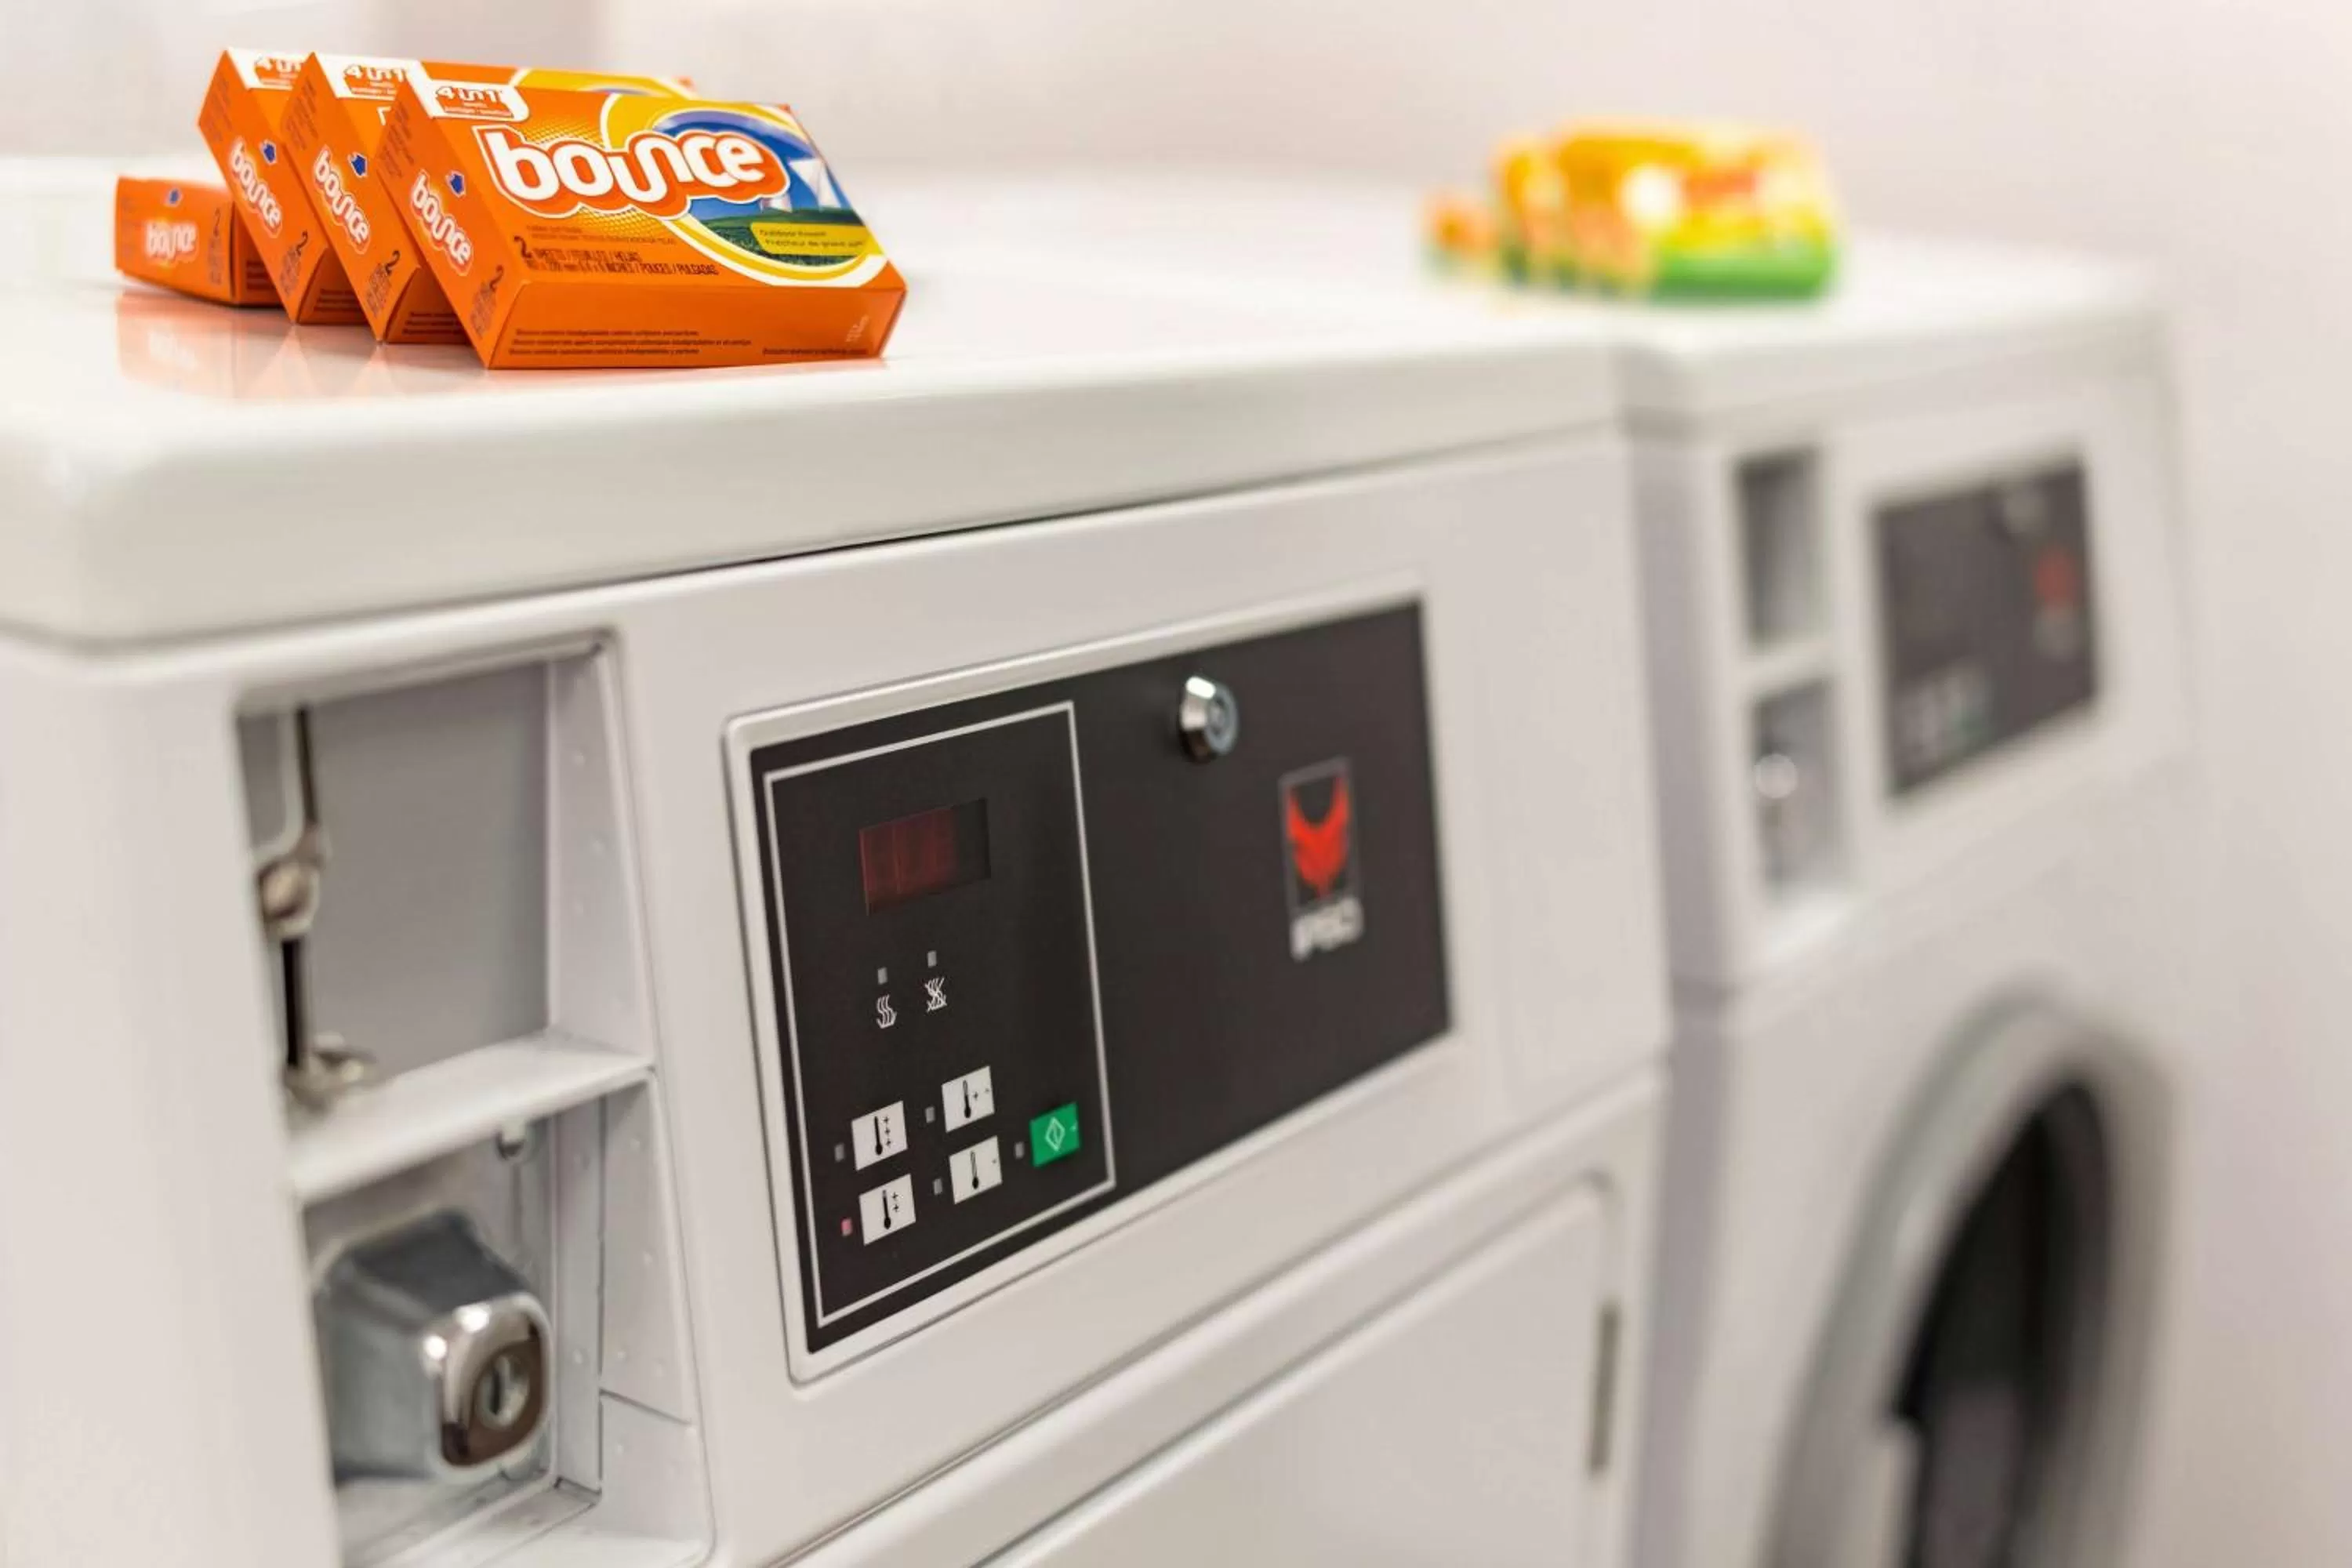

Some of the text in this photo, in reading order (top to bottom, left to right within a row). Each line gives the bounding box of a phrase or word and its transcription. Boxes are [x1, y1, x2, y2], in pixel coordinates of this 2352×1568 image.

[231, 143, 281, 229] bounce
[315, 150, 368, 245] bounce
[487, 129, 765, 203] bounce
[147, 222, 198, 260] bounce
[413, 174, 471, 265] bounce
